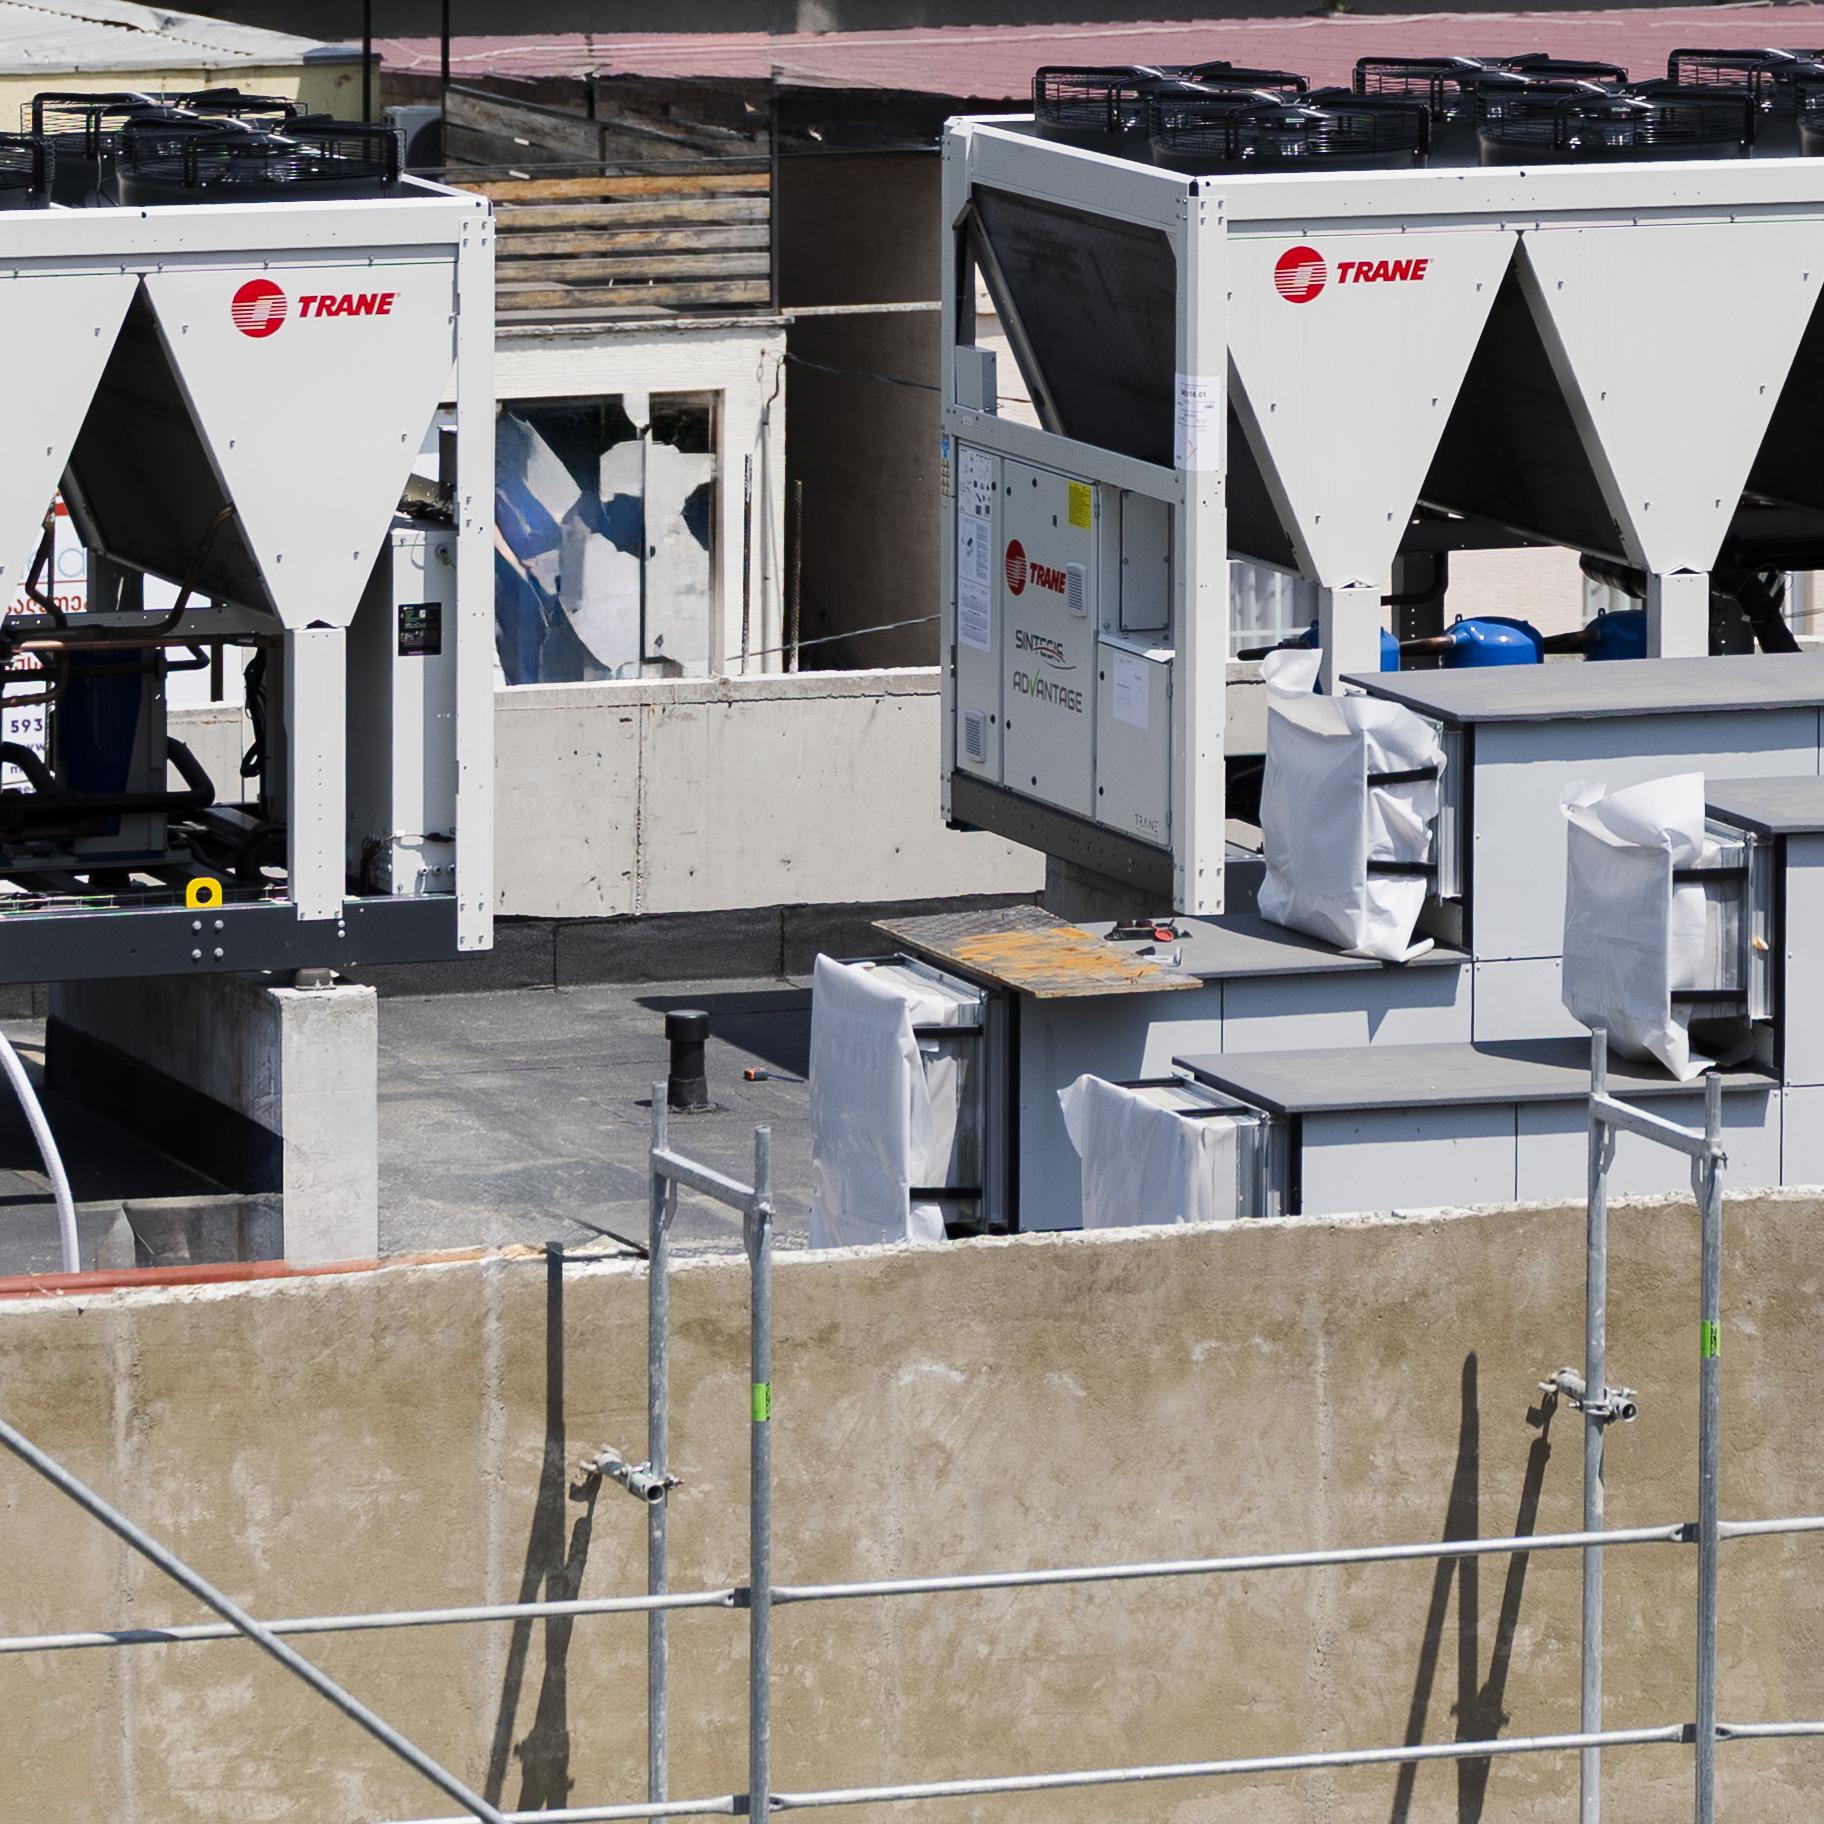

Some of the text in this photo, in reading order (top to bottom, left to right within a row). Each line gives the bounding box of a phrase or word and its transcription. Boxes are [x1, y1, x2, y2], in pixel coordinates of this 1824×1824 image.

[1336, 258, 1430, 285] TRANE
[298, 292, 396, 319] TRANE
[1029, 561, 1067, 595] TRANE
[1015, 629, 1065, 663] SINTESIS
[1012, 668, 1083, 714] ADVANTAGE
[10, 718, 43, 734] 593
